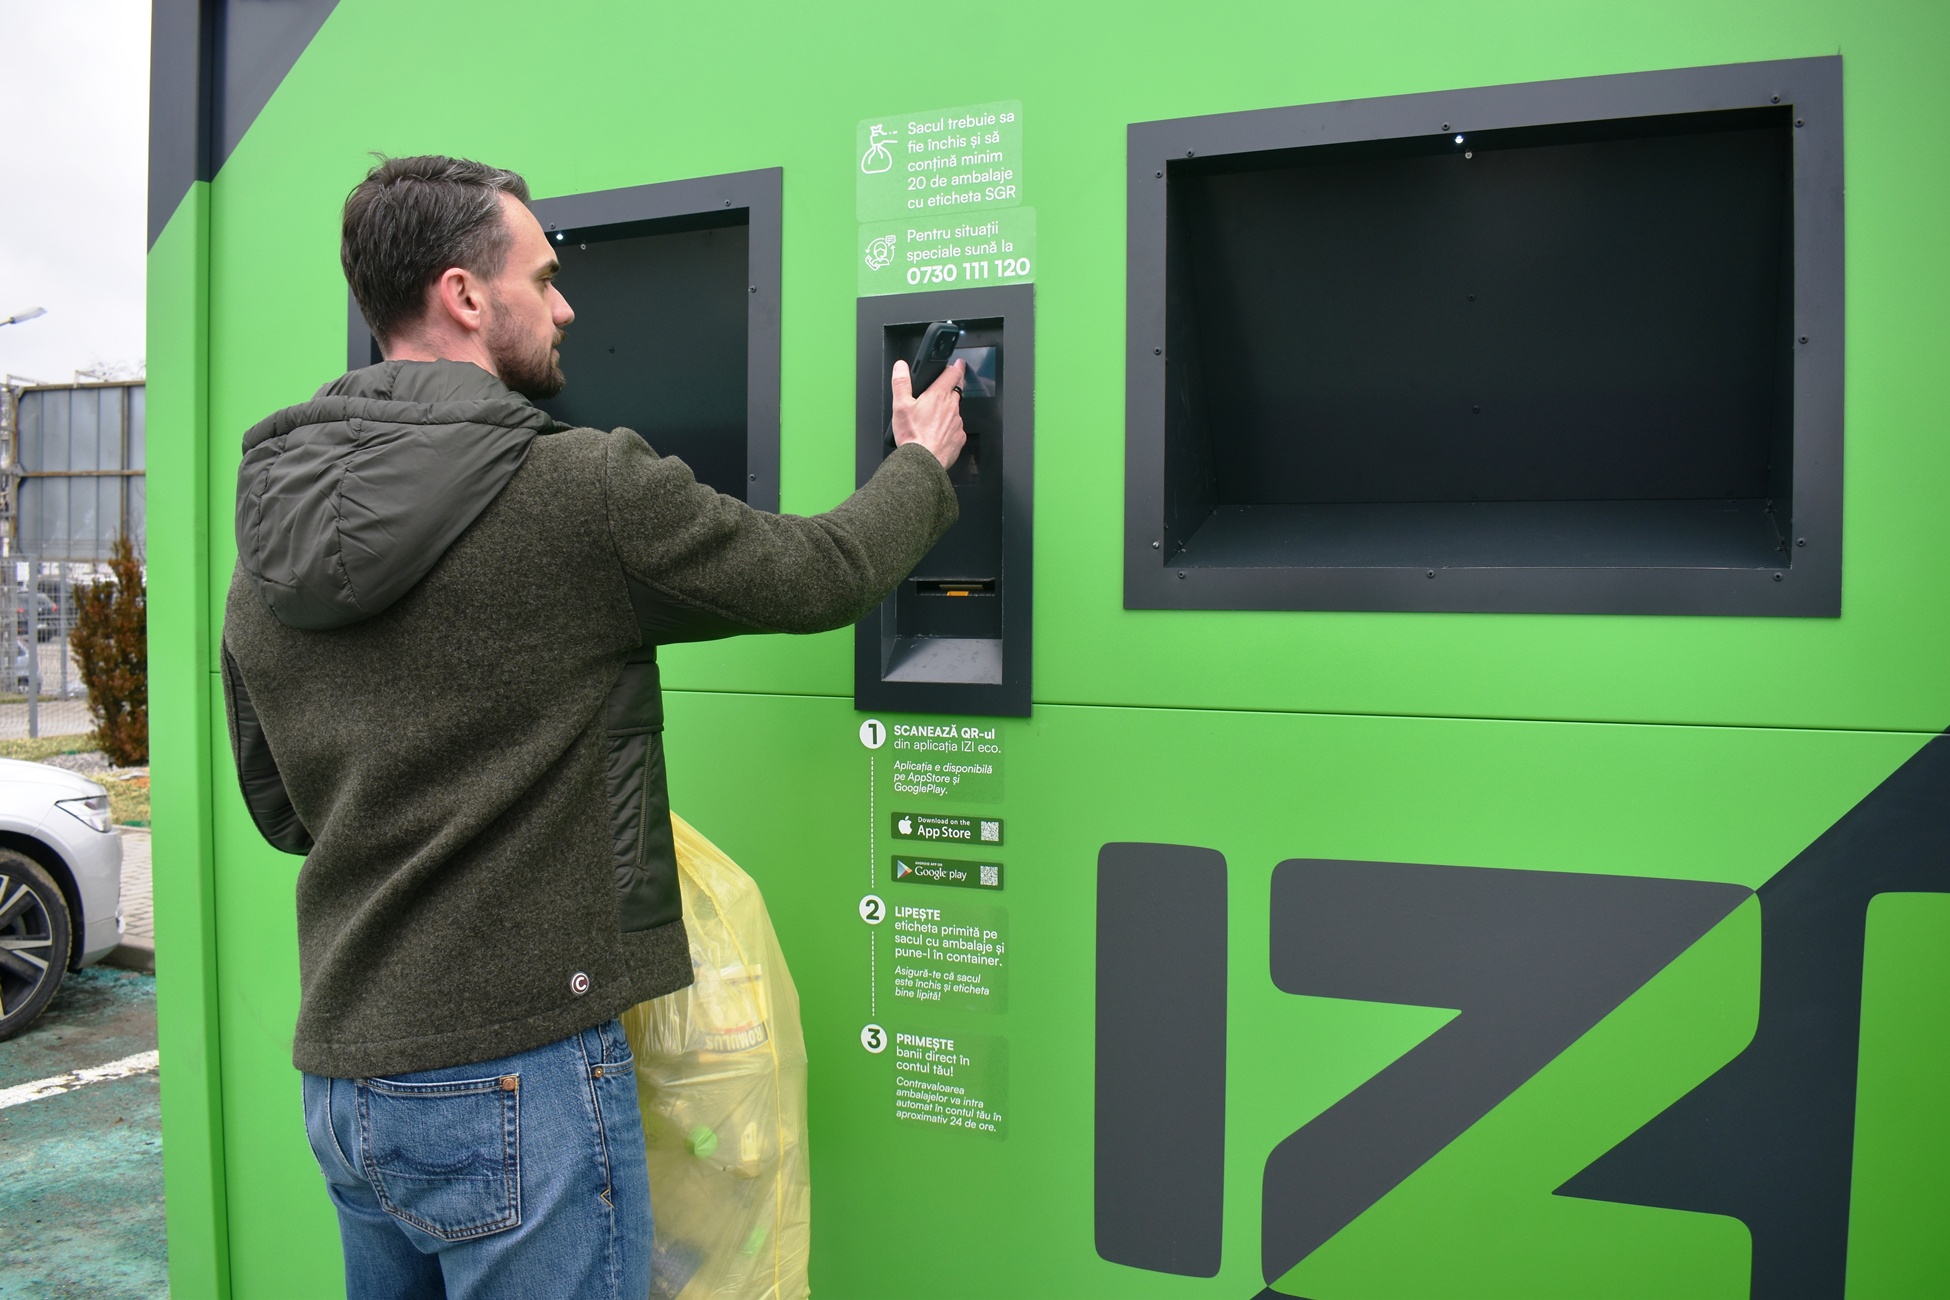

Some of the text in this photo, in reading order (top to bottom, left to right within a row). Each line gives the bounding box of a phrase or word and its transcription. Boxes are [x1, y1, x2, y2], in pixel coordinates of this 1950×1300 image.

[908, 112, 1014, 135] Sacul trebuie sa
[908, 131, 1000, 154] fie închis și să
[907, 150, 1003, 172] conțină minim
[908, 168, 1013, 190] 20 de ambalaje
[908, 185, 1016, 209] cu eticheta SGR
[908, 221, 999, 242] Pentru situații
[907, 239, 1013, 263] speciale sună la
[906, 257, 1031, 285] 0730 111 120
[868, 724, 877, 744] 1
[894, 724, 995, 739] SCANEAZĂ QR-ul
[894, 738, 1001, 753] din aplicația IZI eco.
[894, 760, 932, 772] Aplicația
[943, 763, 993, 774] disponibilă
[894, 773, 960, 785] pe AppStore și
[894, 782, 948, 796] GooglePlay.
[918, 817, 948, 825] Download
[918, 825, 971, 839] App Store
[915, 866, 967, 881] Google play
[866, 899, 879, 920] 2
[895, 906, 941, 921] LIPEȘTE
[895, 920, 997, 940] eticheta primită pe
[895, 934, 1005, 955] sacul cu ambalaje și
[895, 947, 1002, 967] pune-l în container.
[895, 966, 981, 983] Asigură-te că sacul
[895, 978, 990, 996] este închis și eticheta
[895, 987, 941, 1002] bine lipită!
[705, 1026, 765, 1050] ROMULUS
[867, 1028, 881, 1049] 3
[896, 1033, 954, 1052] PRIMEȘTE
[896, 1047, 970, 1066] banii direct în
[896, 1061, 954, 1076] contul tău!
[896, 1076, 965, 1095] Contravaloarea
[896, 1088, 984, 1108] ambalajelor va intra
[896, 1099, 1002, 1122] automat în contul tău în
[896, 1110, 996, 1132] aproximativ 24 de ore.
